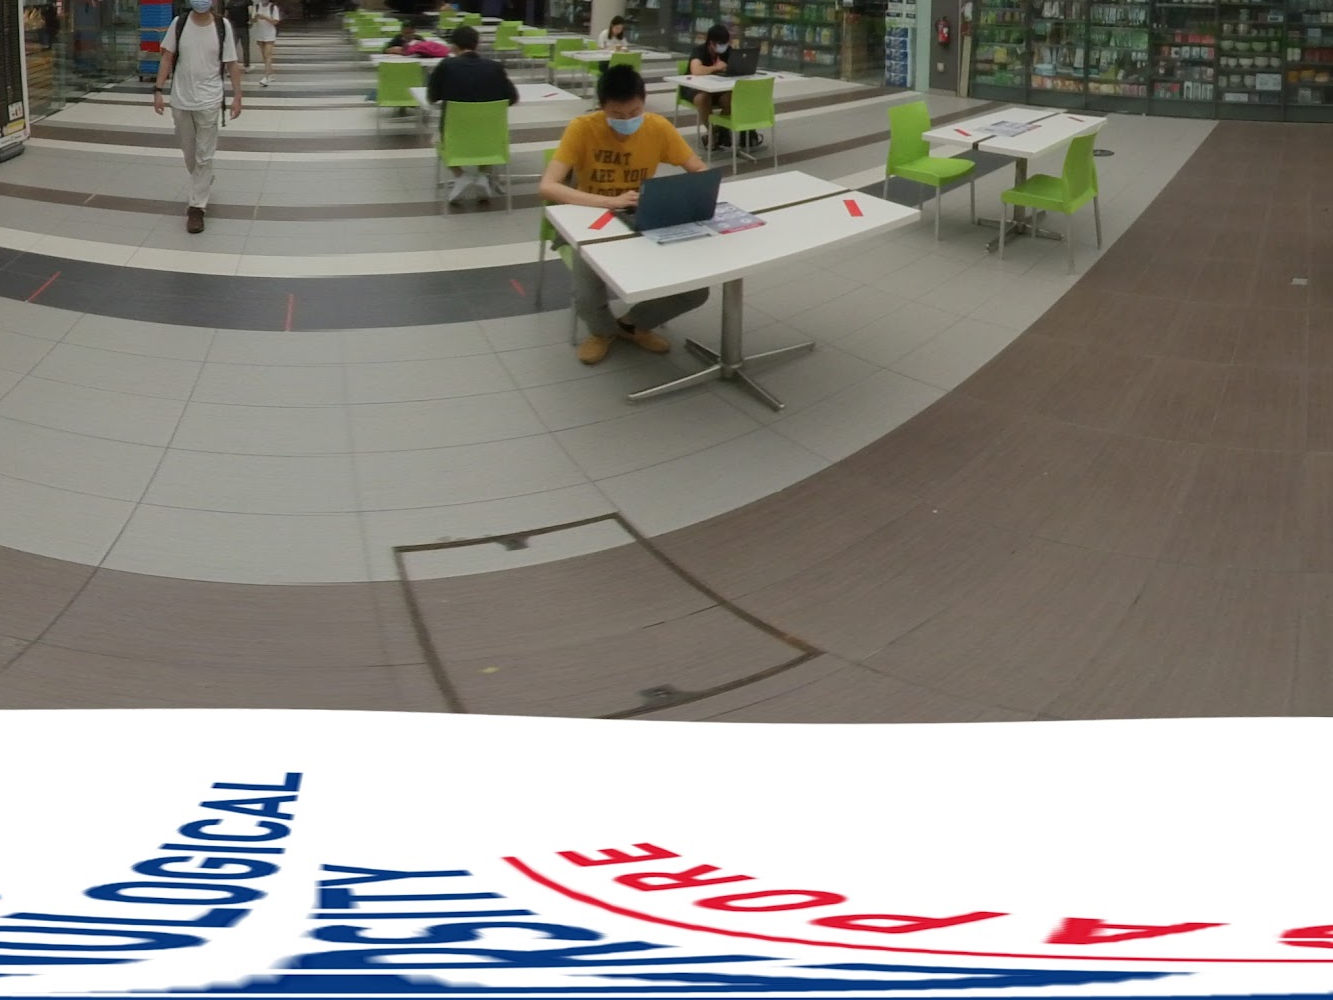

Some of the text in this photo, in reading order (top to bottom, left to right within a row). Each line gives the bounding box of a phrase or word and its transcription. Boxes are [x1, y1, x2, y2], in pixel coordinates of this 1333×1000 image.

[594, 149, 631, 166] WHAT
[590, 168, 648, 183] ARE YOU
